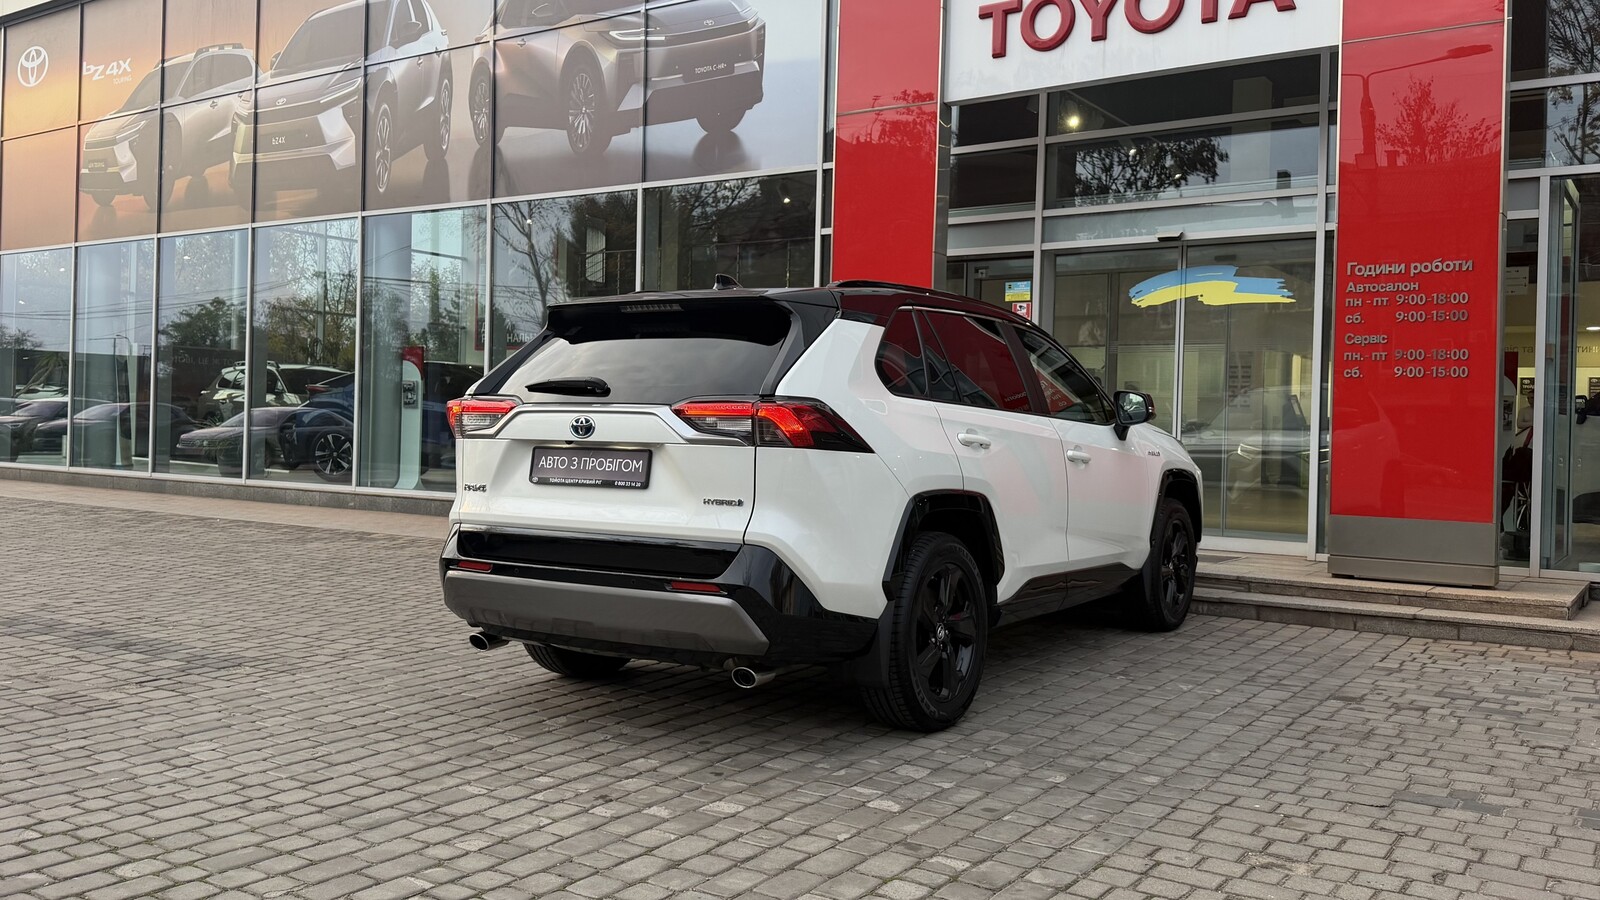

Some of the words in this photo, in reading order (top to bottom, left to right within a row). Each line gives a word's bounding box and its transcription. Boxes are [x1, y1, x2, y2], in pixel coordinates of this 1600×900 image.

[695, 65, 712, 74] TOYOTA
[1346, 261, 1406, 278] Години
[1410, 257, 1473, 277] роботи
[1345, 281, 1419, 293] Автосалон
[1345, 313, 1365, 324] сб.
[1344, 333, 1388, 347] Сервіс
[1371, 352, 1388, 361] пт
[1343, 366, 1363, 378] сб.
[538, 456, 568, 469] АВТО
[580, 458, 643, 473] ПРОБІГОМ
[703, 498, 737, 507] HYBRID
